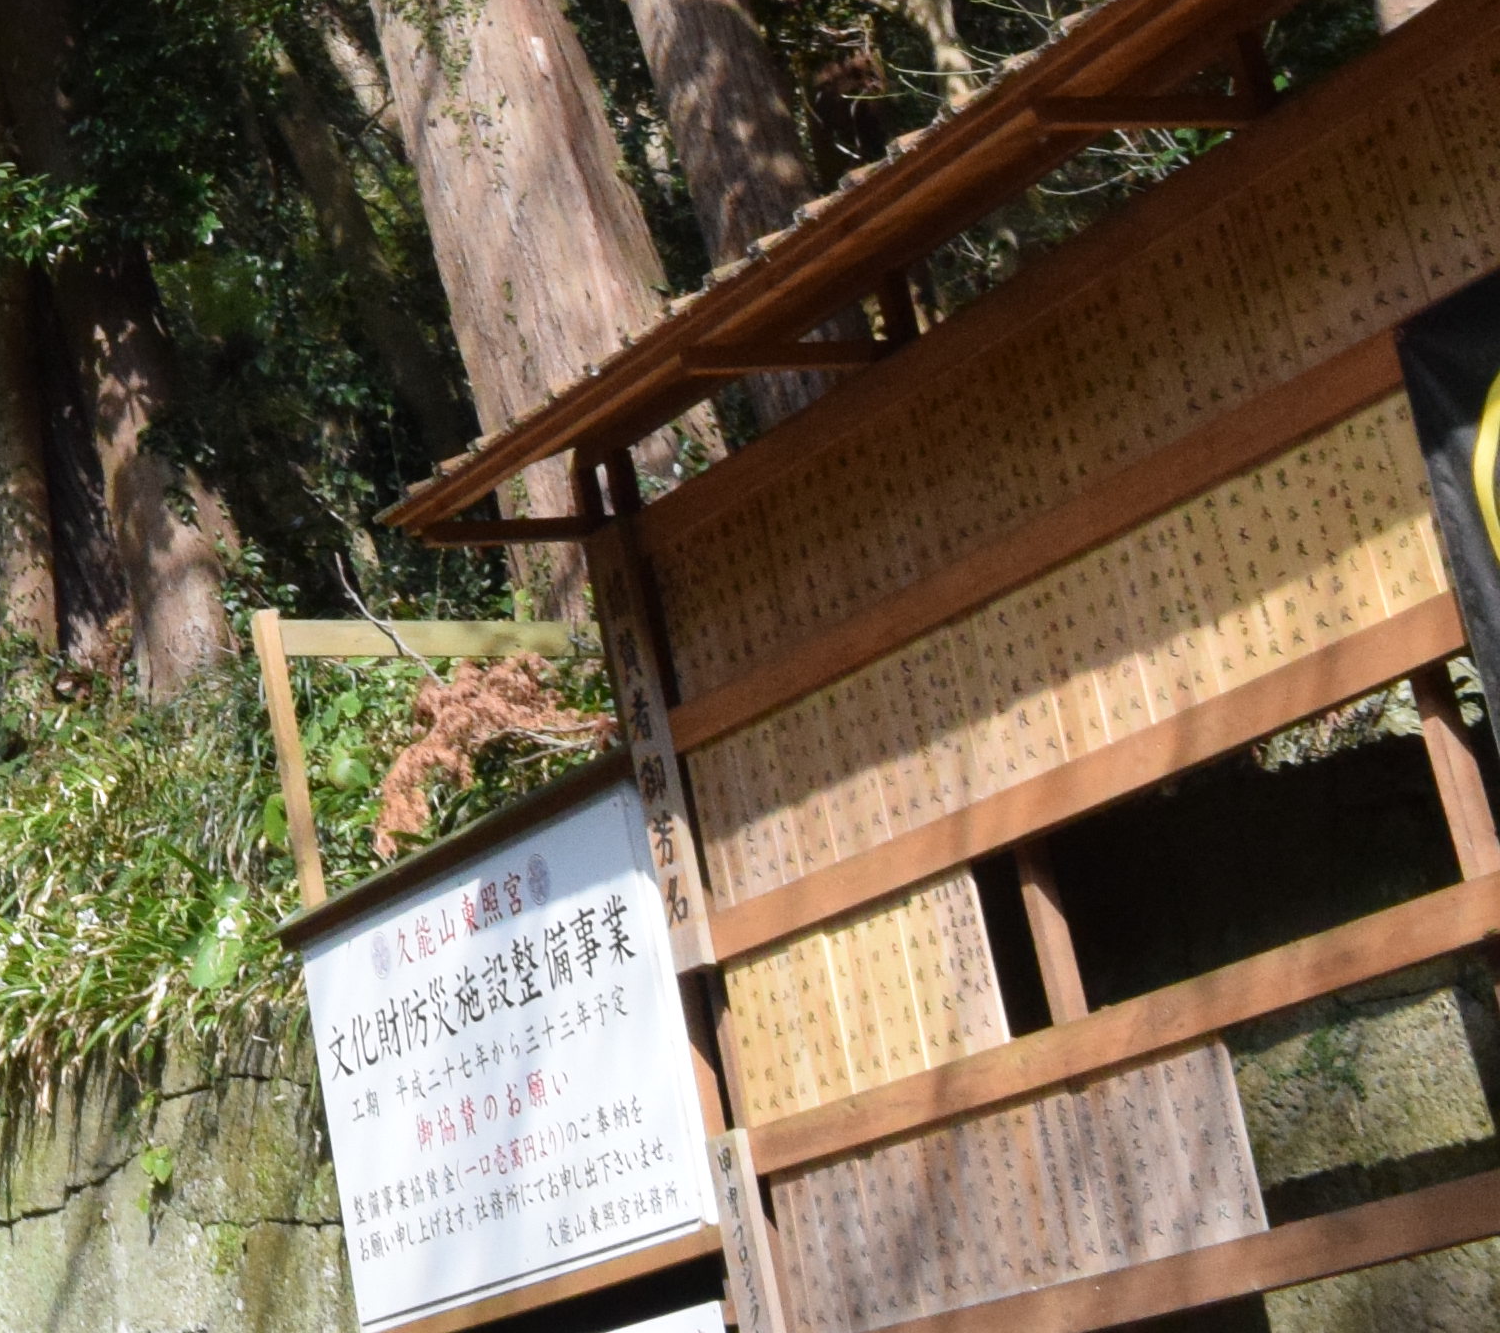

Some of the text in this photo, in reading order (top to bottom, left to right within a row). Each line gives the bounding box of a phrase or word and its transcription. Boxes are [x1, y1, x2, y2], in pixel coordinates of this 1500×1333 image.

[395, 871, 523, 967] 久能山東照宮
[328, 893, 638, 1081] 文化財防災施設整備事業
[351, 984, 629, 1123] 工期 平成二十七年から三十三年予定
[414, 1069, 570, 1153] 御協賛のお願い
